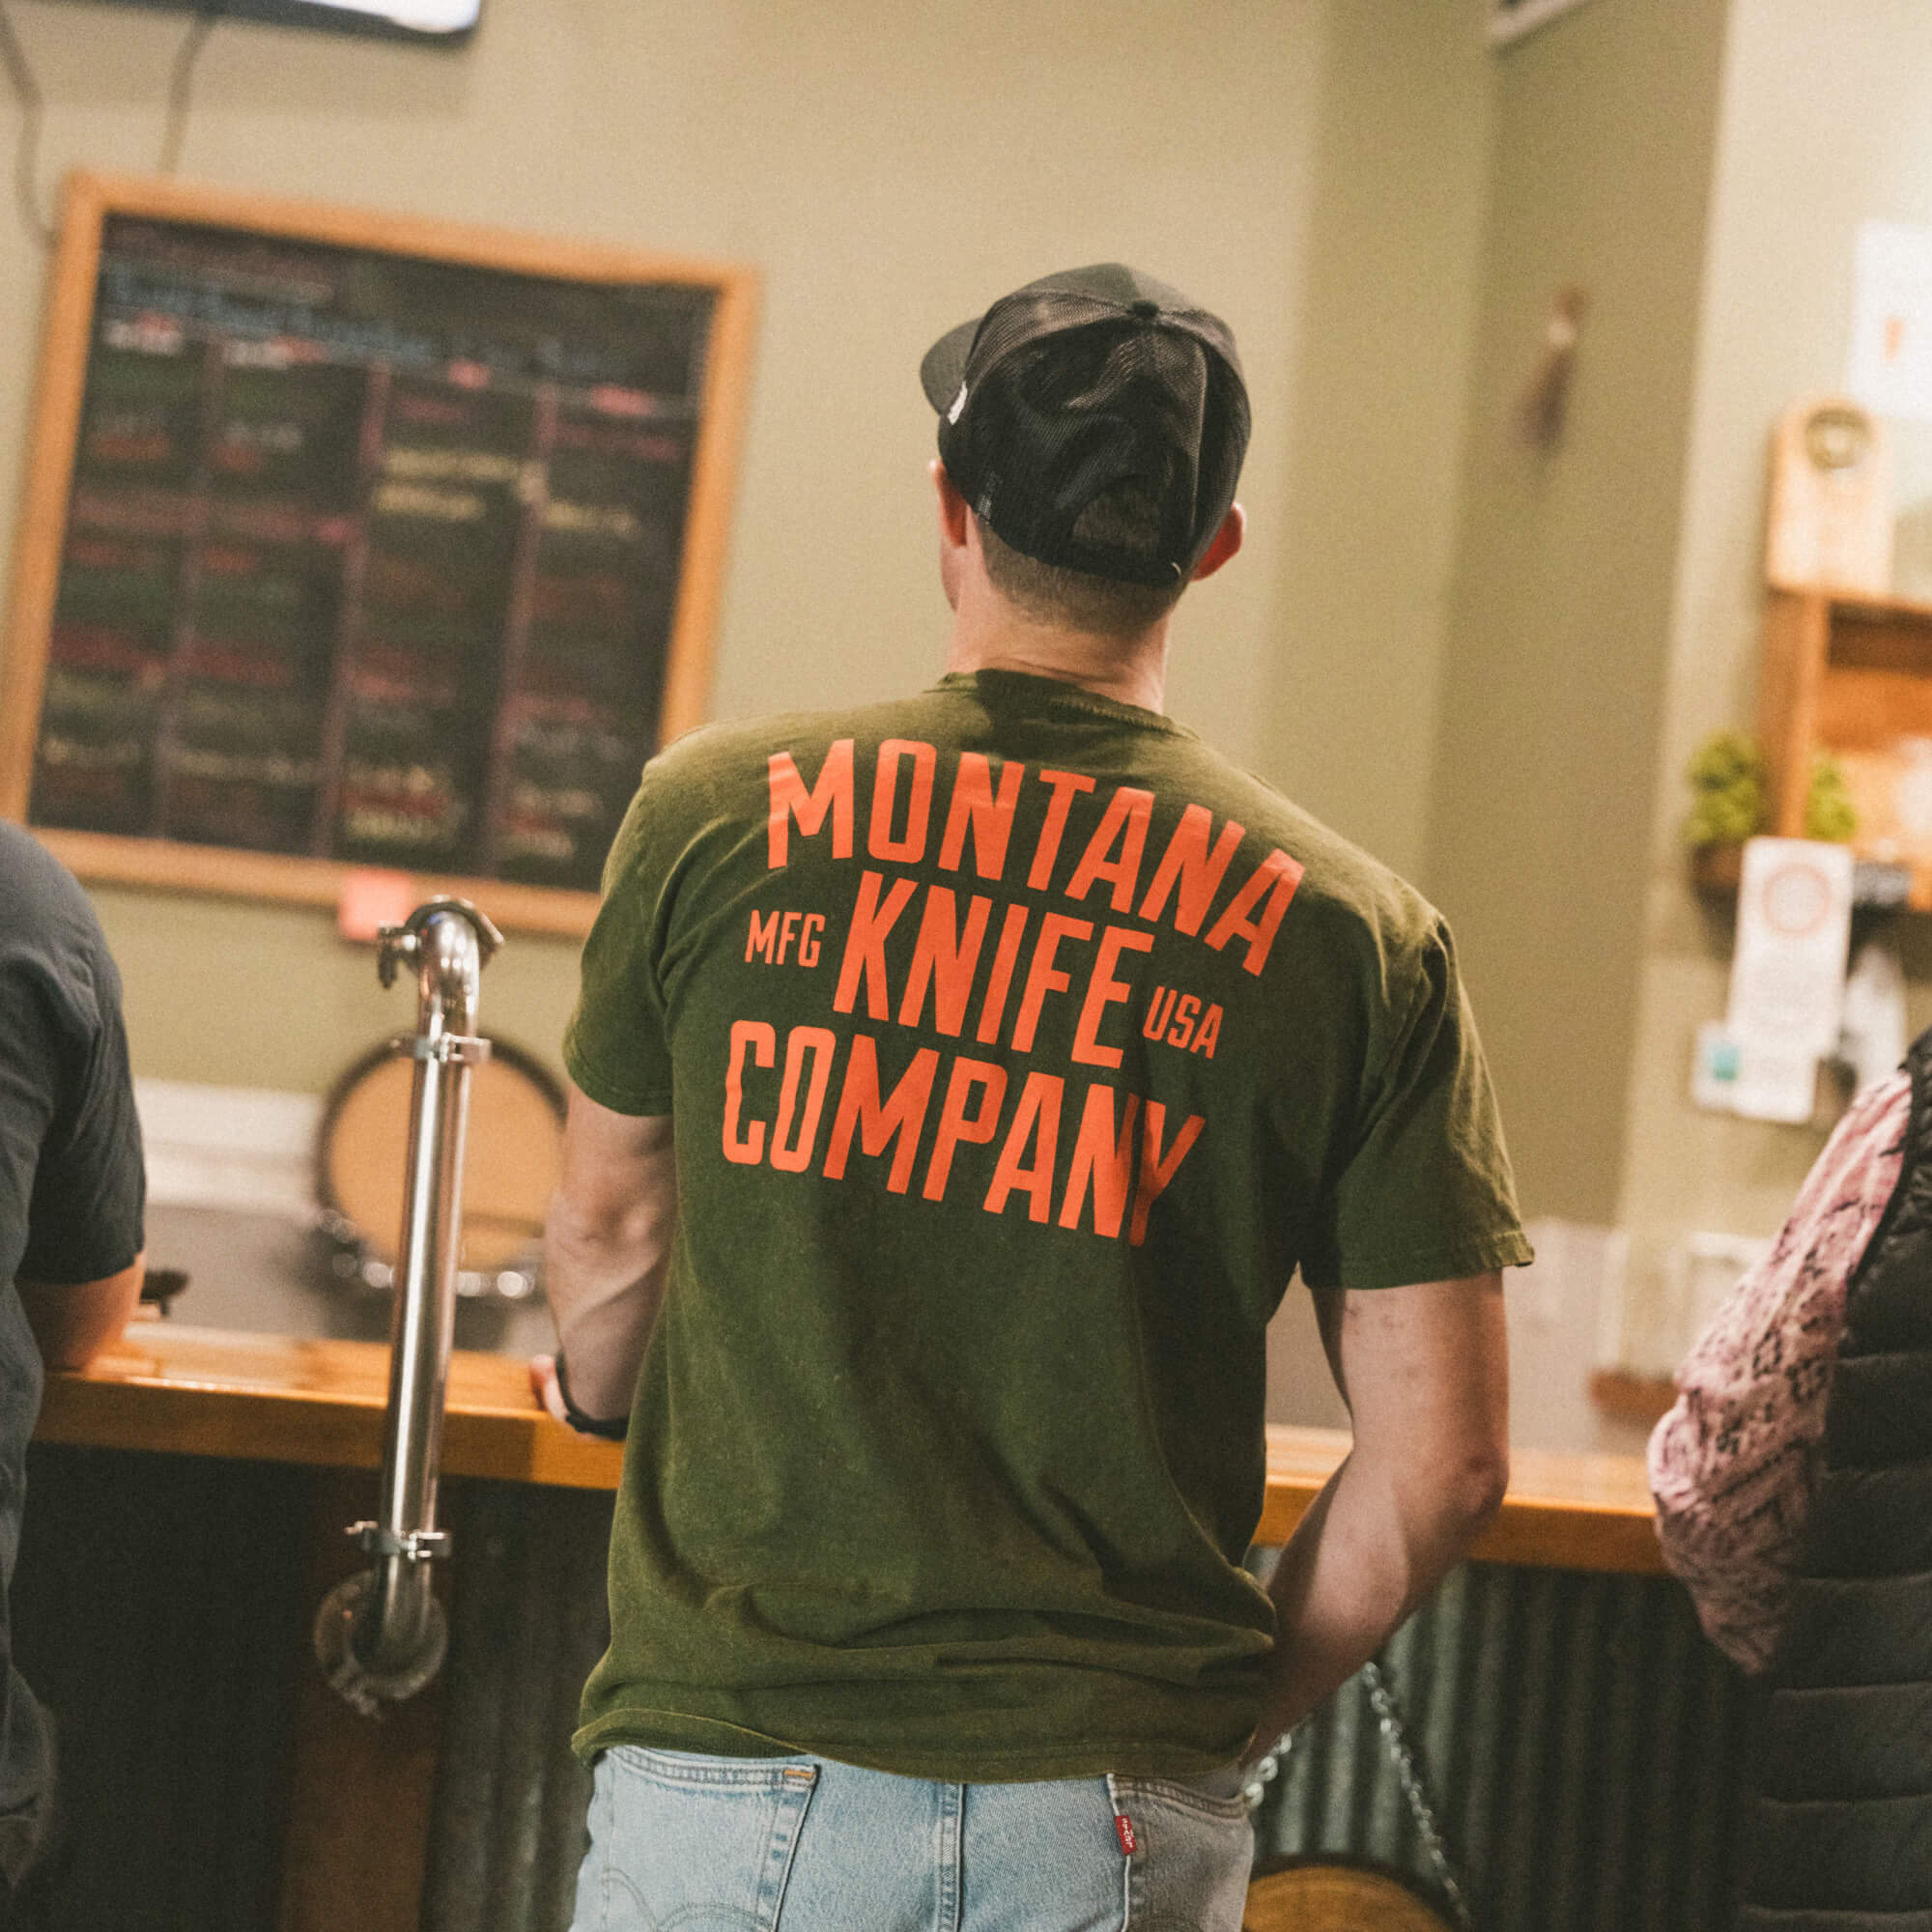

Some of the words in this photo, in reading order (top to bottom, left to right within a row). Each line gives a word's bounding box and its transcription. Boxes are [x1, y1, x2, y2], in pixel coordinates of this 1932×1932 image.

[745, 909, 826, 968] MFG
[832, 869, 1155, 1069] KNIFE
[1143, 985, 1224, 1060] USA
[767, 738, 1305, 977] MONTANA
[722, 1019, 1206, 1247] COMPANY
